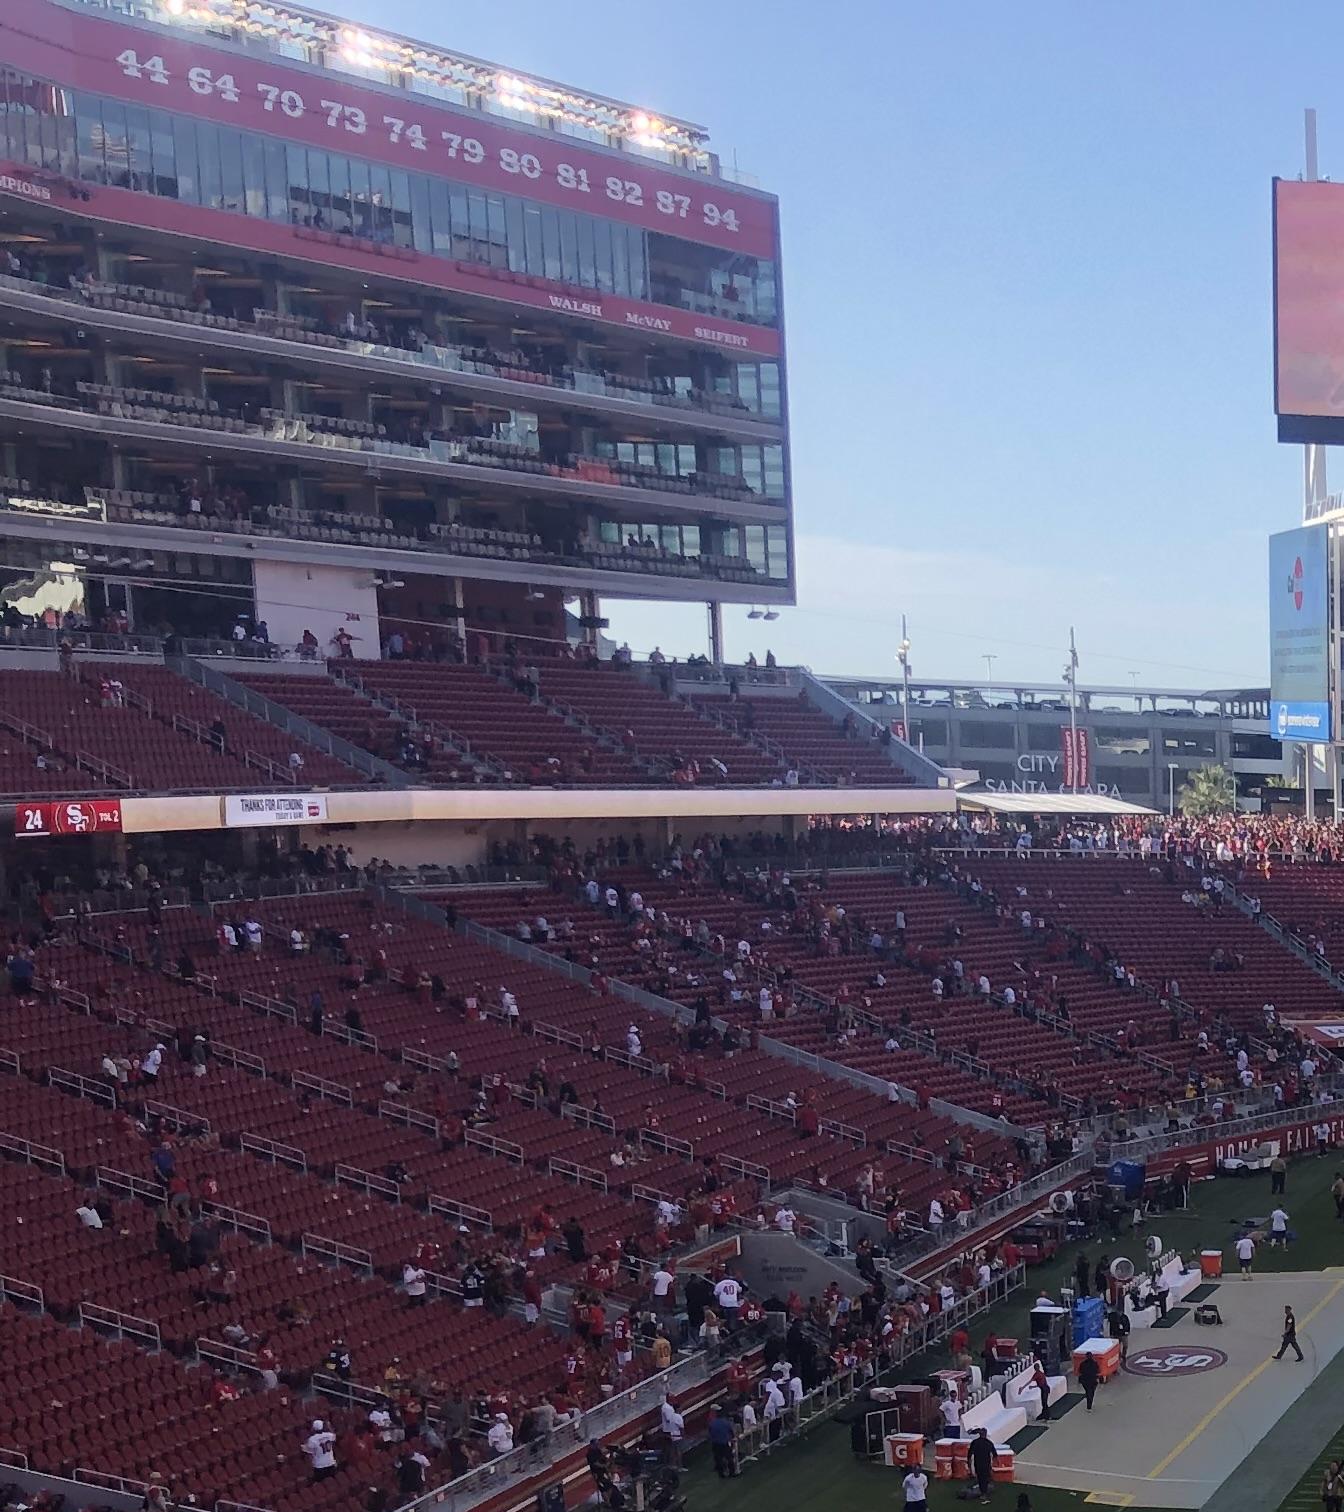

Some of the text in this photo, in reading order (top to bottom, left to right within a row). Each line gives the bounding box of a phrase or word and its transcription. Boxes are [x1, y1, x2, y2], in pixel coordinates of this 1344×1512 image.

[116, 49, 741, 232] 44 64 70 73 74 79 80 81 82 87 94
[549, 296, 602, 317] WALSH
[626, 312, 672, 331] McVAY
[694, 327, 749, 347] SEIFERT
[1017, 755, 1059, 772] CITY
[241, 799, 265, 812] THANKS
[24, 808, 43, 831] 24
